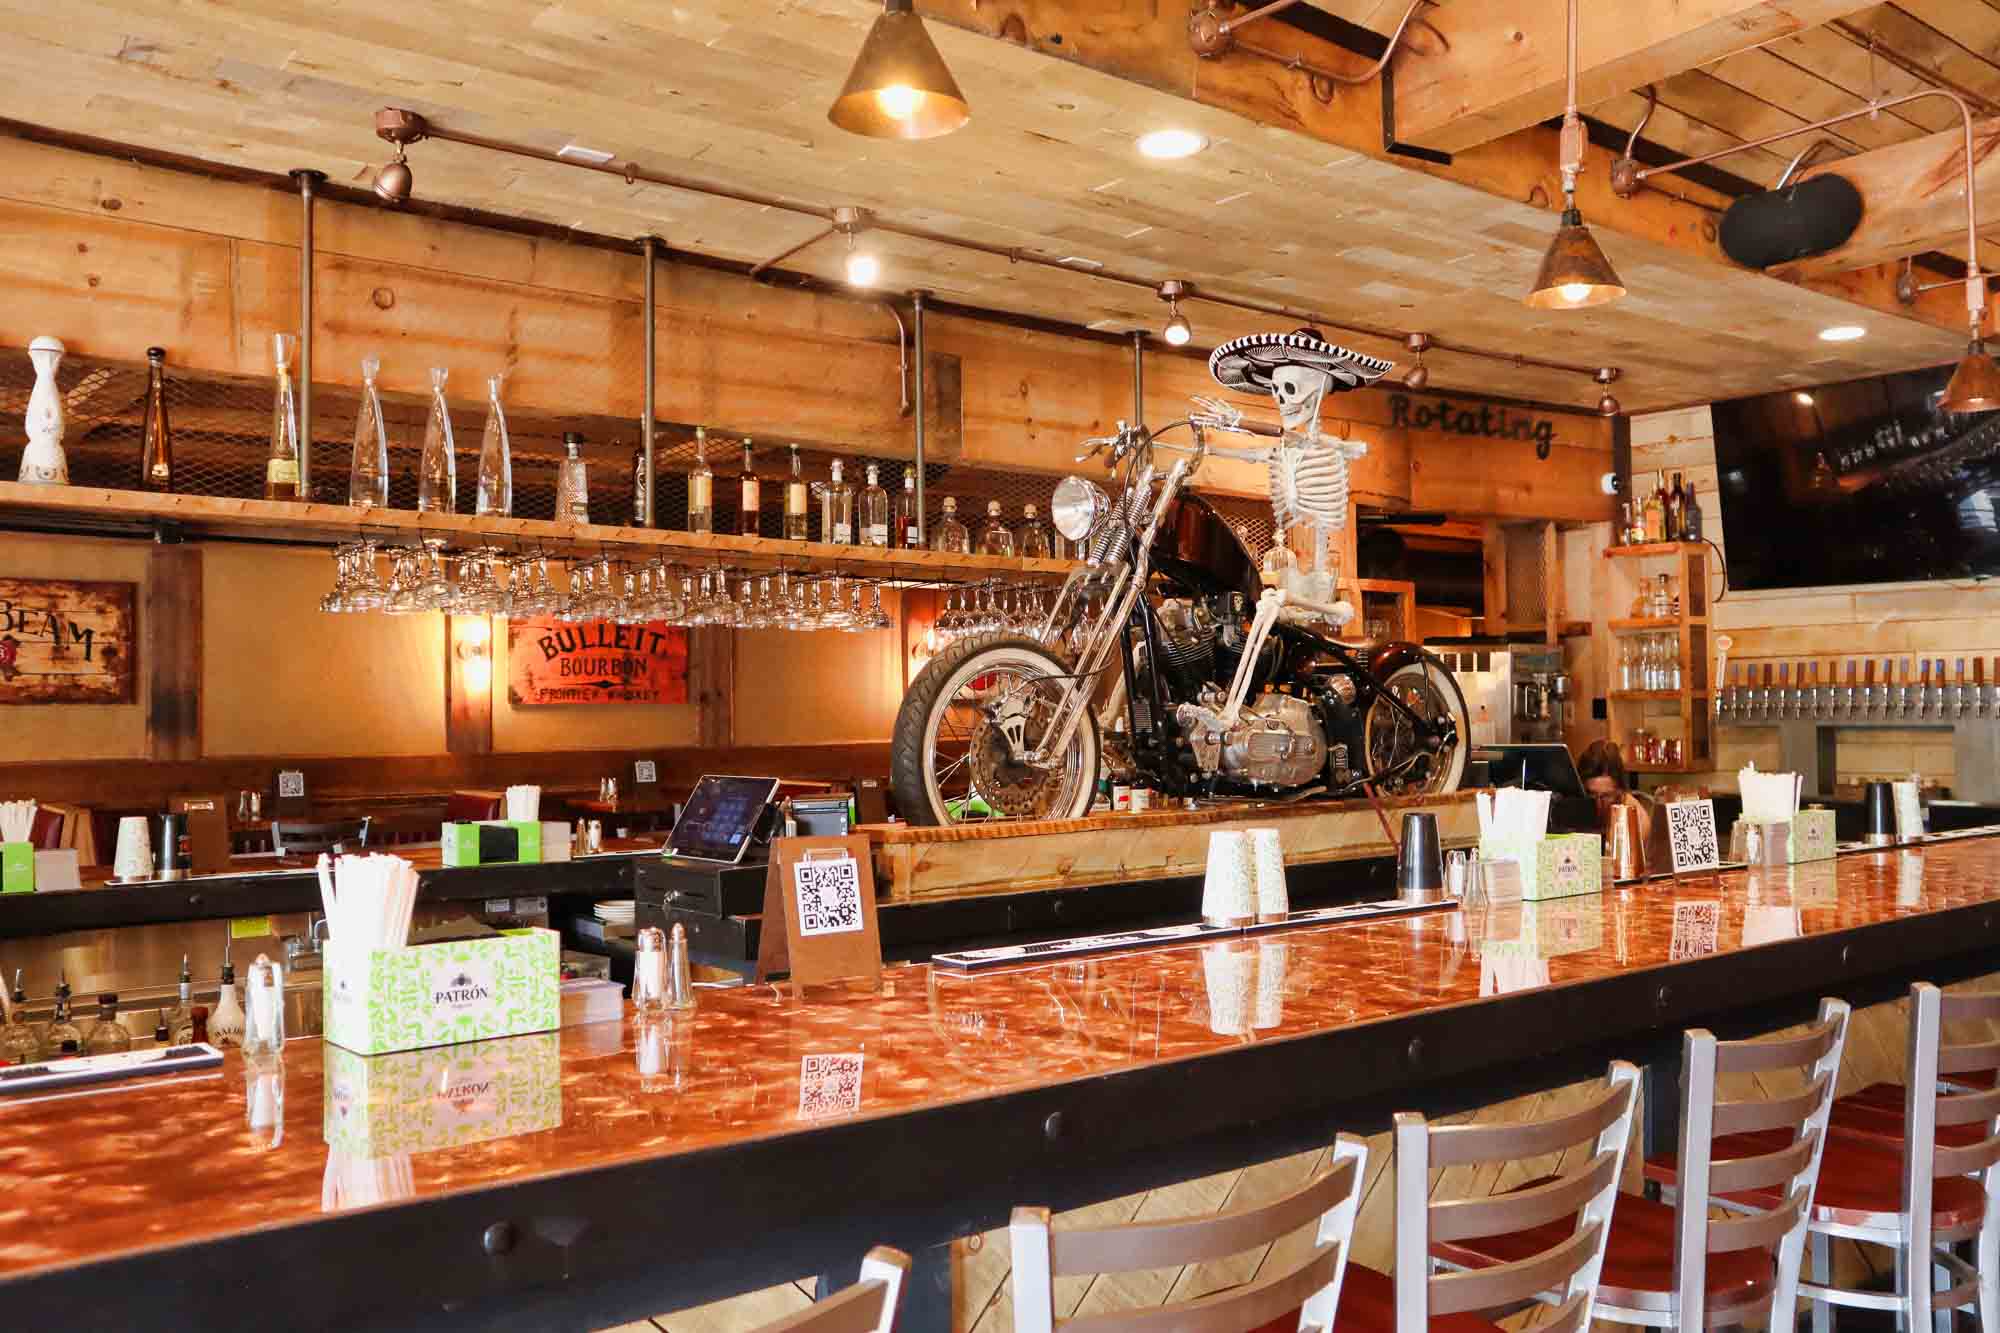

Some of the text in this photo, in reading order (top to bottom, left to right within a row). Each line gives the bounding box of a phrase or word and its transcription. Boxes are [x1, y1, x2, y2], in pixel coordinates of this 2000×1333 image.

[1387, 394, 1552, 460] Rotating
[538, 623, 666, 662] BULLEIT
[560, 656, 648, 677] BOURBON
[435, 984, 489, 1004] PATRÓN
